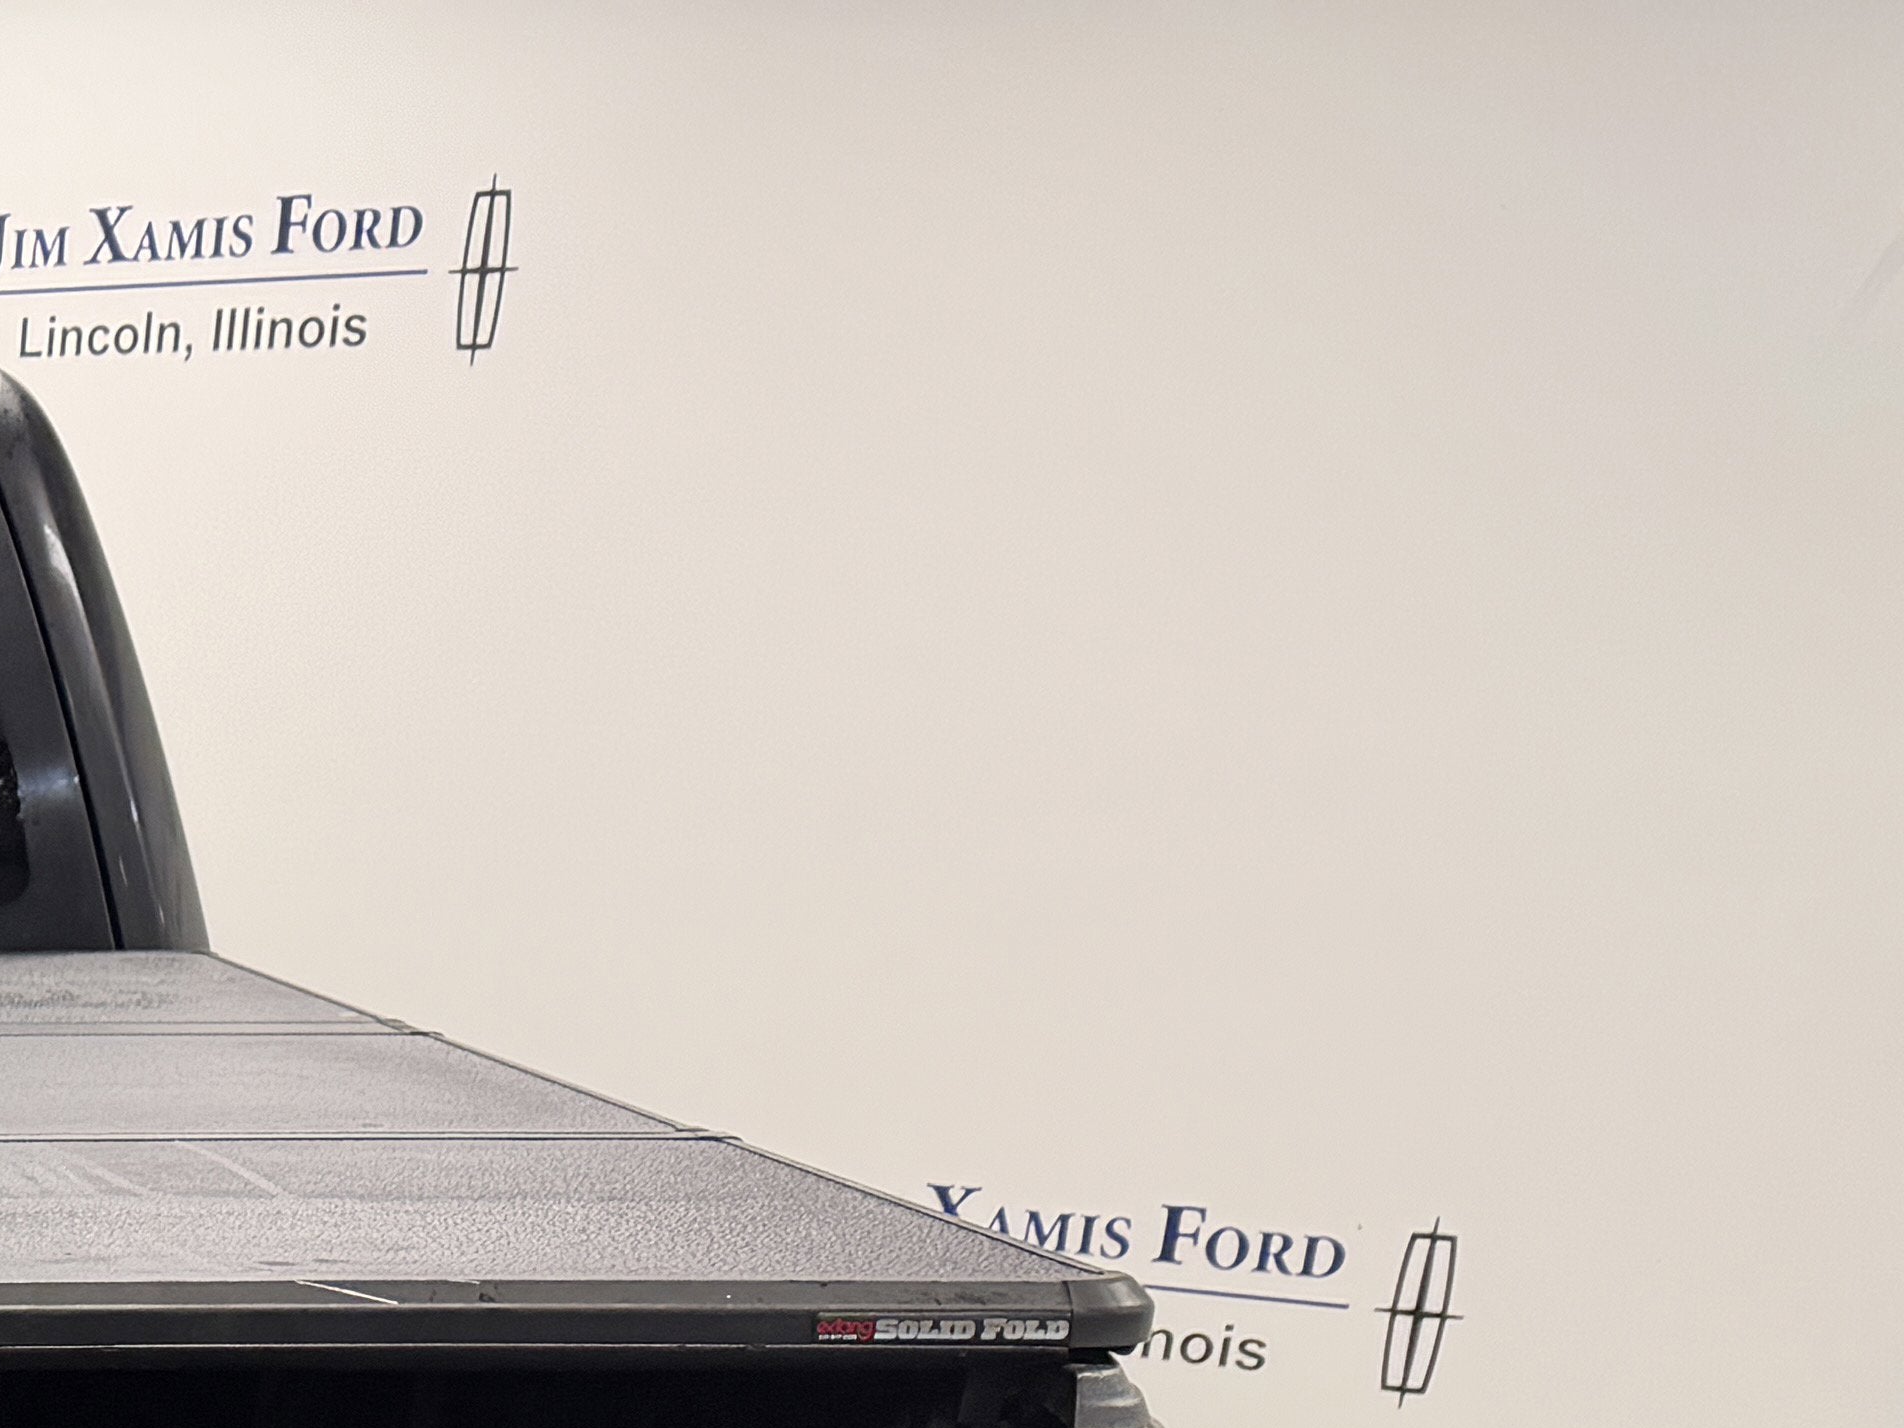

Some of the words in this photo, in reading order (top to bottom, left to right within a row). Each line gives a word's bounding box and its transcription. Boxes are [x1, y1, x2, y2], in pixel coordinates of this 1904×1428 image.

[83, 204, 255, 266] XAMIS
[270, 192, 424, 256] FORD
[18, 310, 194, 363] Lincoln,
[212, 303, 368, 352] Illinois
[1150, 1203, 1348, 1279] FORD
[874, 1318, 976, 1340] SOLID
[980, 1317, 1070, 1341] FOLD
